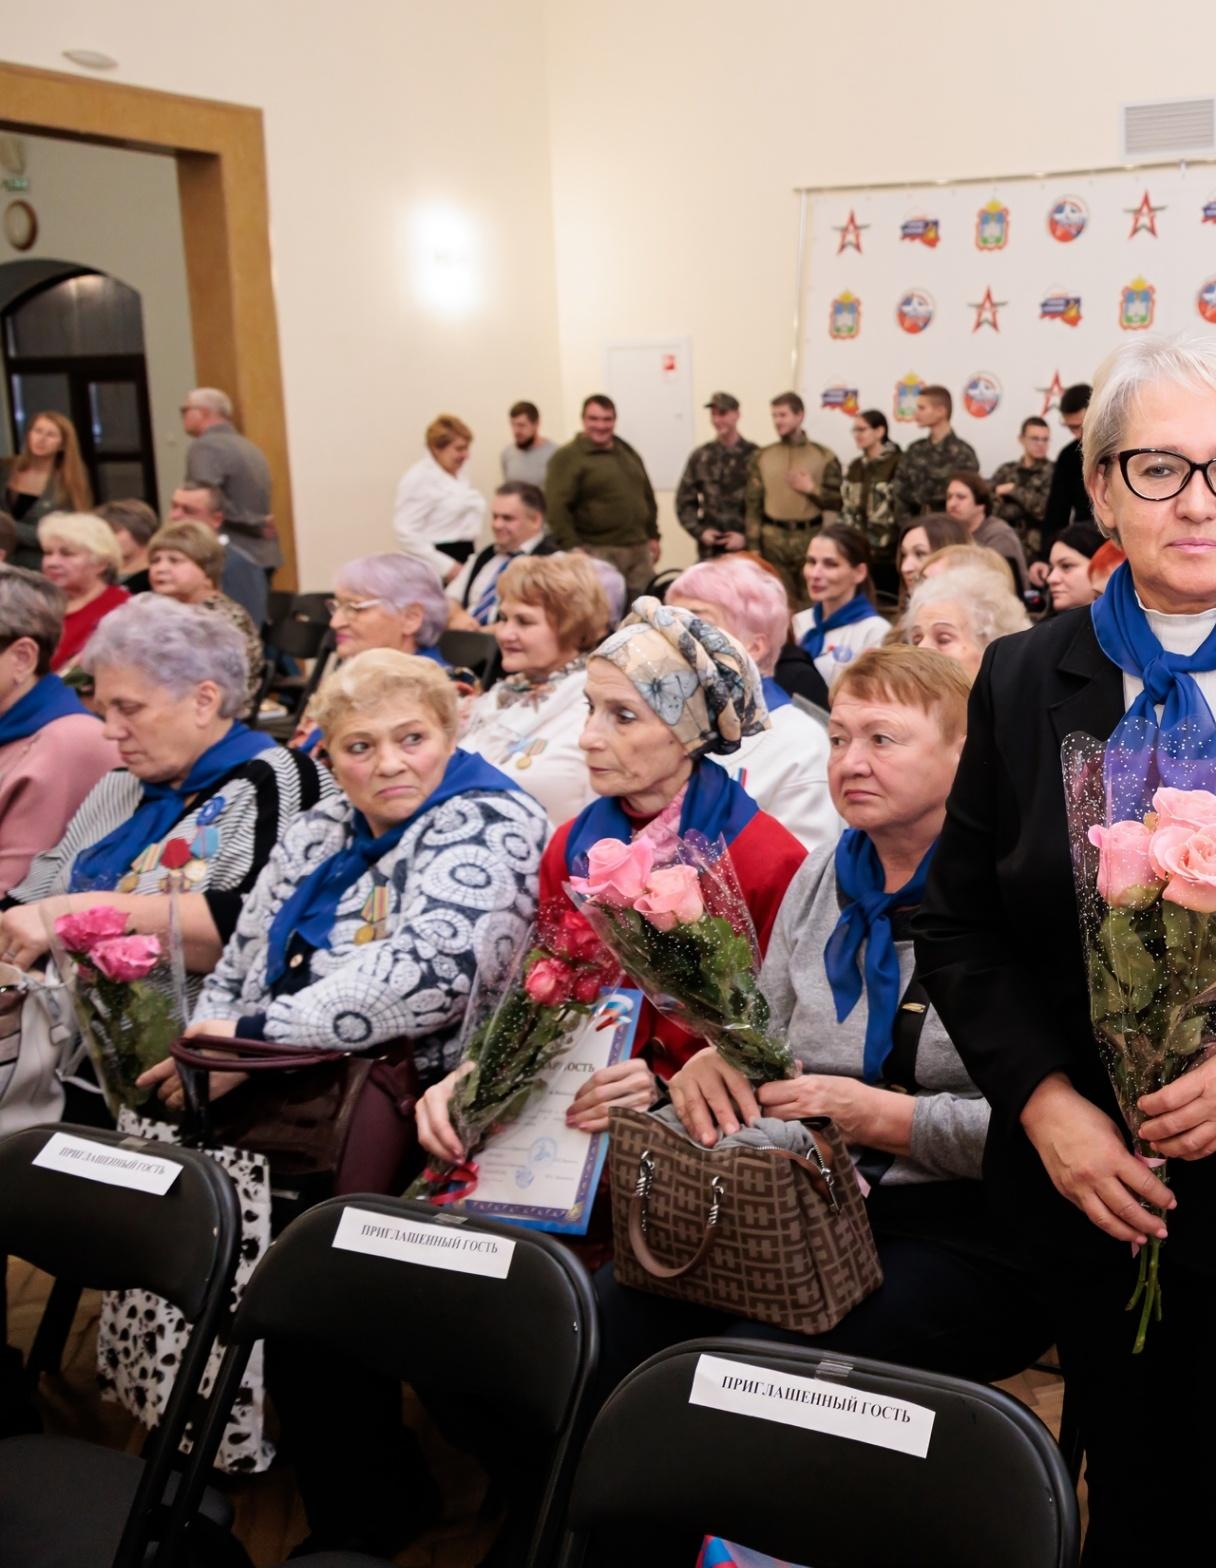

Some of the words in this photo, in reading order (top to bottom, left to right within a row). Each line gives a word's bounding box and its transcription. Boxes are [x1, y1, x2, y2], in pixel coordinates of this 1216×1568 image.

[361, 1224, 461, 1249] ПРИГЛАШЕННЫЙ
[462, 1240, 498, 1253] ГОСТЬ
[722, 1376, 857, 1412] ПРИГЛАШЕННЫЙ
[861, 1402, 911, 1423] ГОСТЬ
